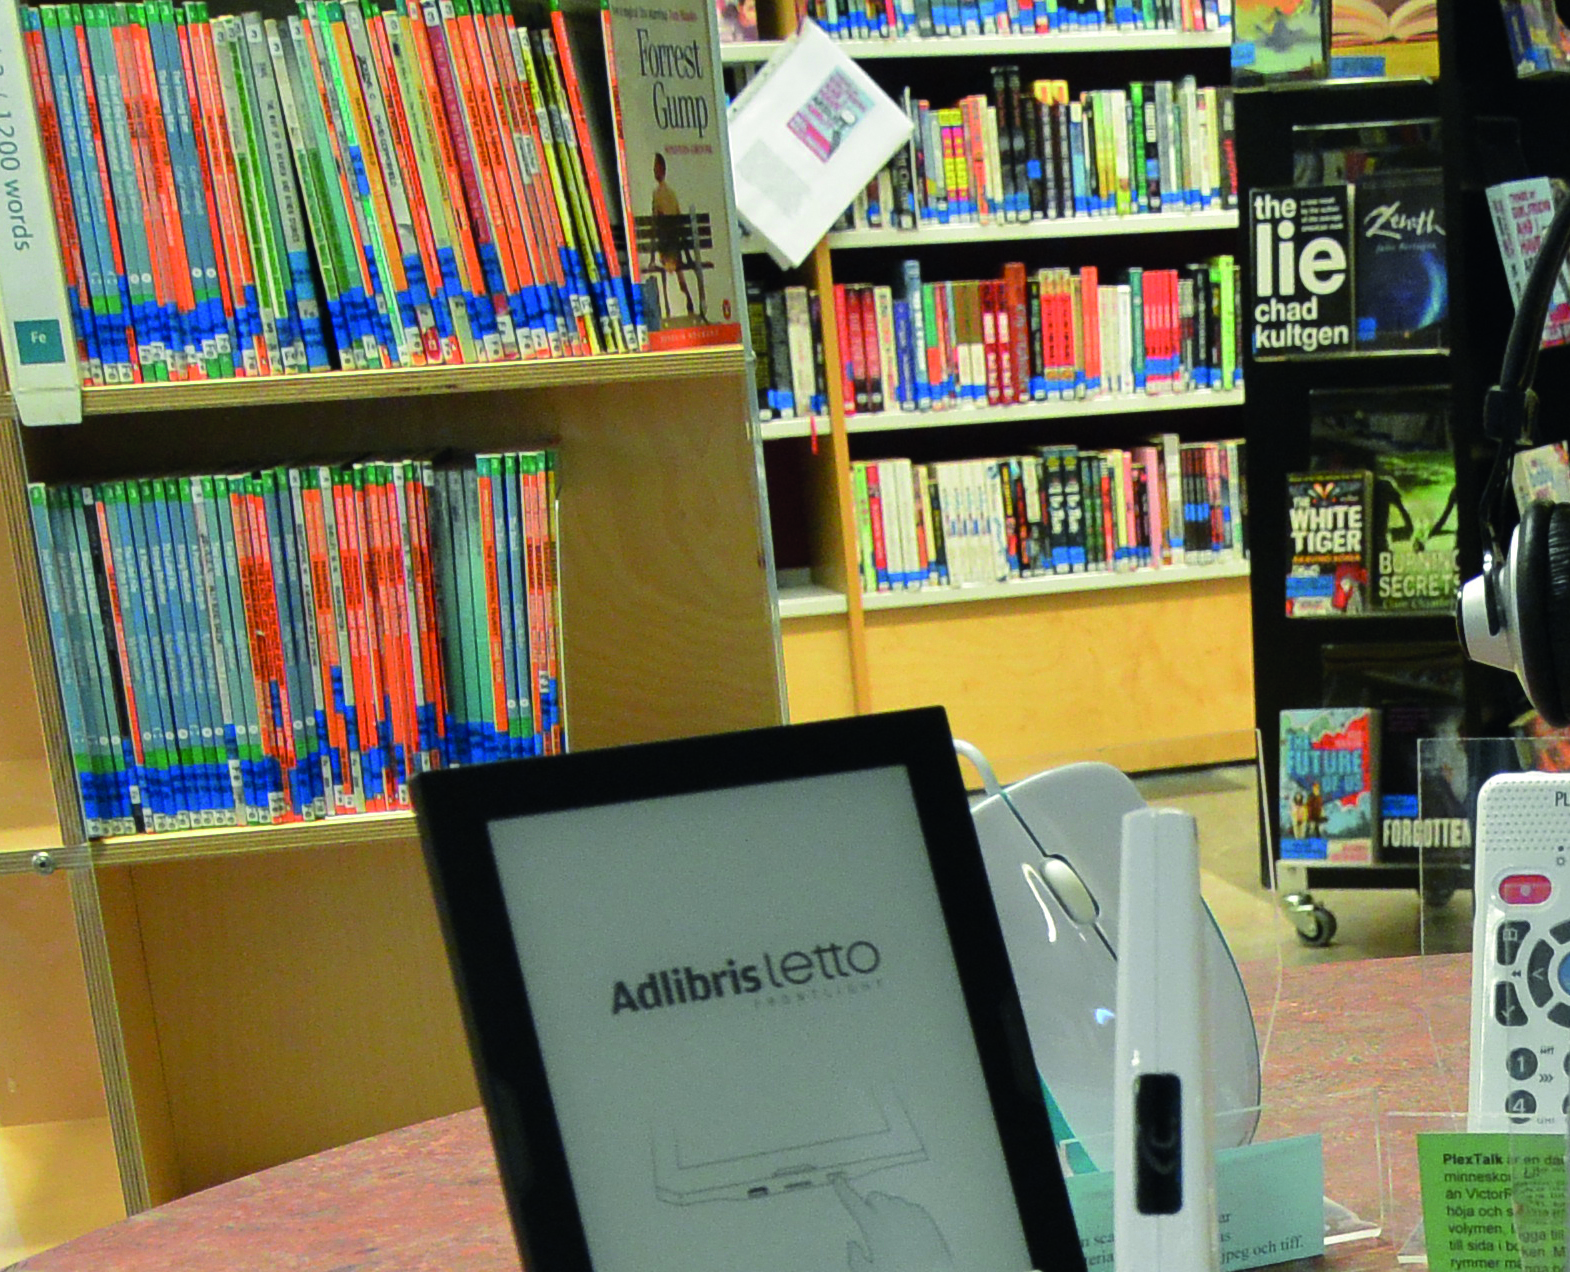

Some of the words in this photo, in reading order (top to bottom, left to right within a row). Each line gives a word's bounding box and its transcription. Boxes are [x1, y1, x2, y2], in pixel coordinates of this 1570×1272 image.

[636, 28, 704, 79] Forrest
[653, 81, 708, 138] Gump
[4, 179, 33, 251] words
[1254, 194, 1296, 219] the
[1256, 219, 1347, 296] lie
[1254, 296, 1317, 322] chad
[30, 330, 47, 344] Fe
[1254, 324, 1349, 351] kultgen
[1290, 505, 1362, 530] WHITE
[1291, 530, 1362, 553] TIGER
[1382, 818, 1472, 848] FORGOTTEN
[1442, 1153, 1503, 1166] PlexTalk
[1446, 1204, 1475, 1218] höja
[1478, 1205, 1503, 1217] och
[1253, 1241, 1277, 1258] och
[1467, 1240, 1494, 1252] sida
[1450, 1257, 1500, 1270] rymmer
